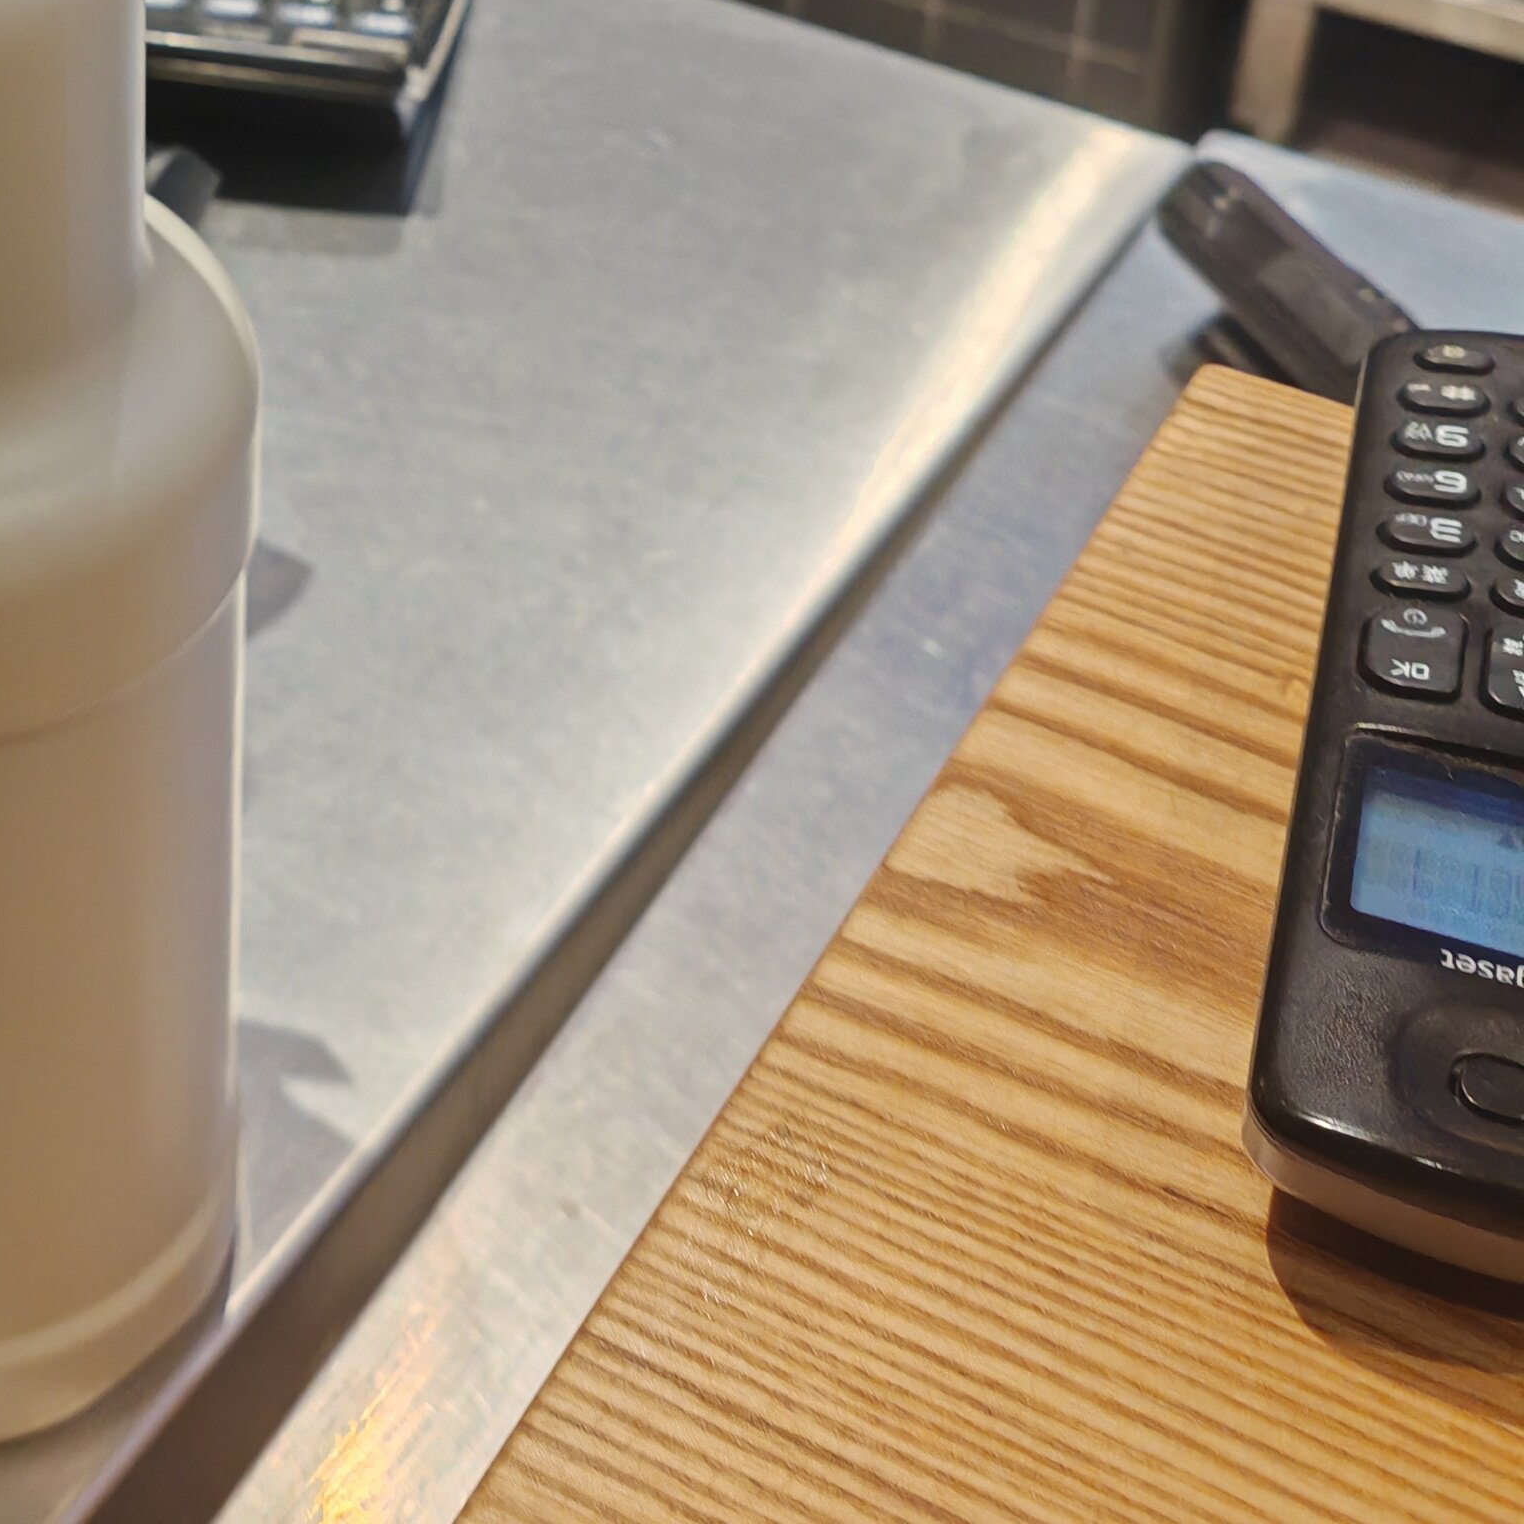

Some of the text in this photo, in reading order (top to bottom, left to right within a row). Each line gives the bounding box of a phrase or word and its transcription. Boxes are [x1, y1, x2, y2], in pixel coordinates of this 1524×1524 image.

[1434, 424, 1469, 448] 9
[1433, 469, 1468, 494] 6
[1429, 517, 1463, 544] 3
[1389, 657, 1430, 681] OK
